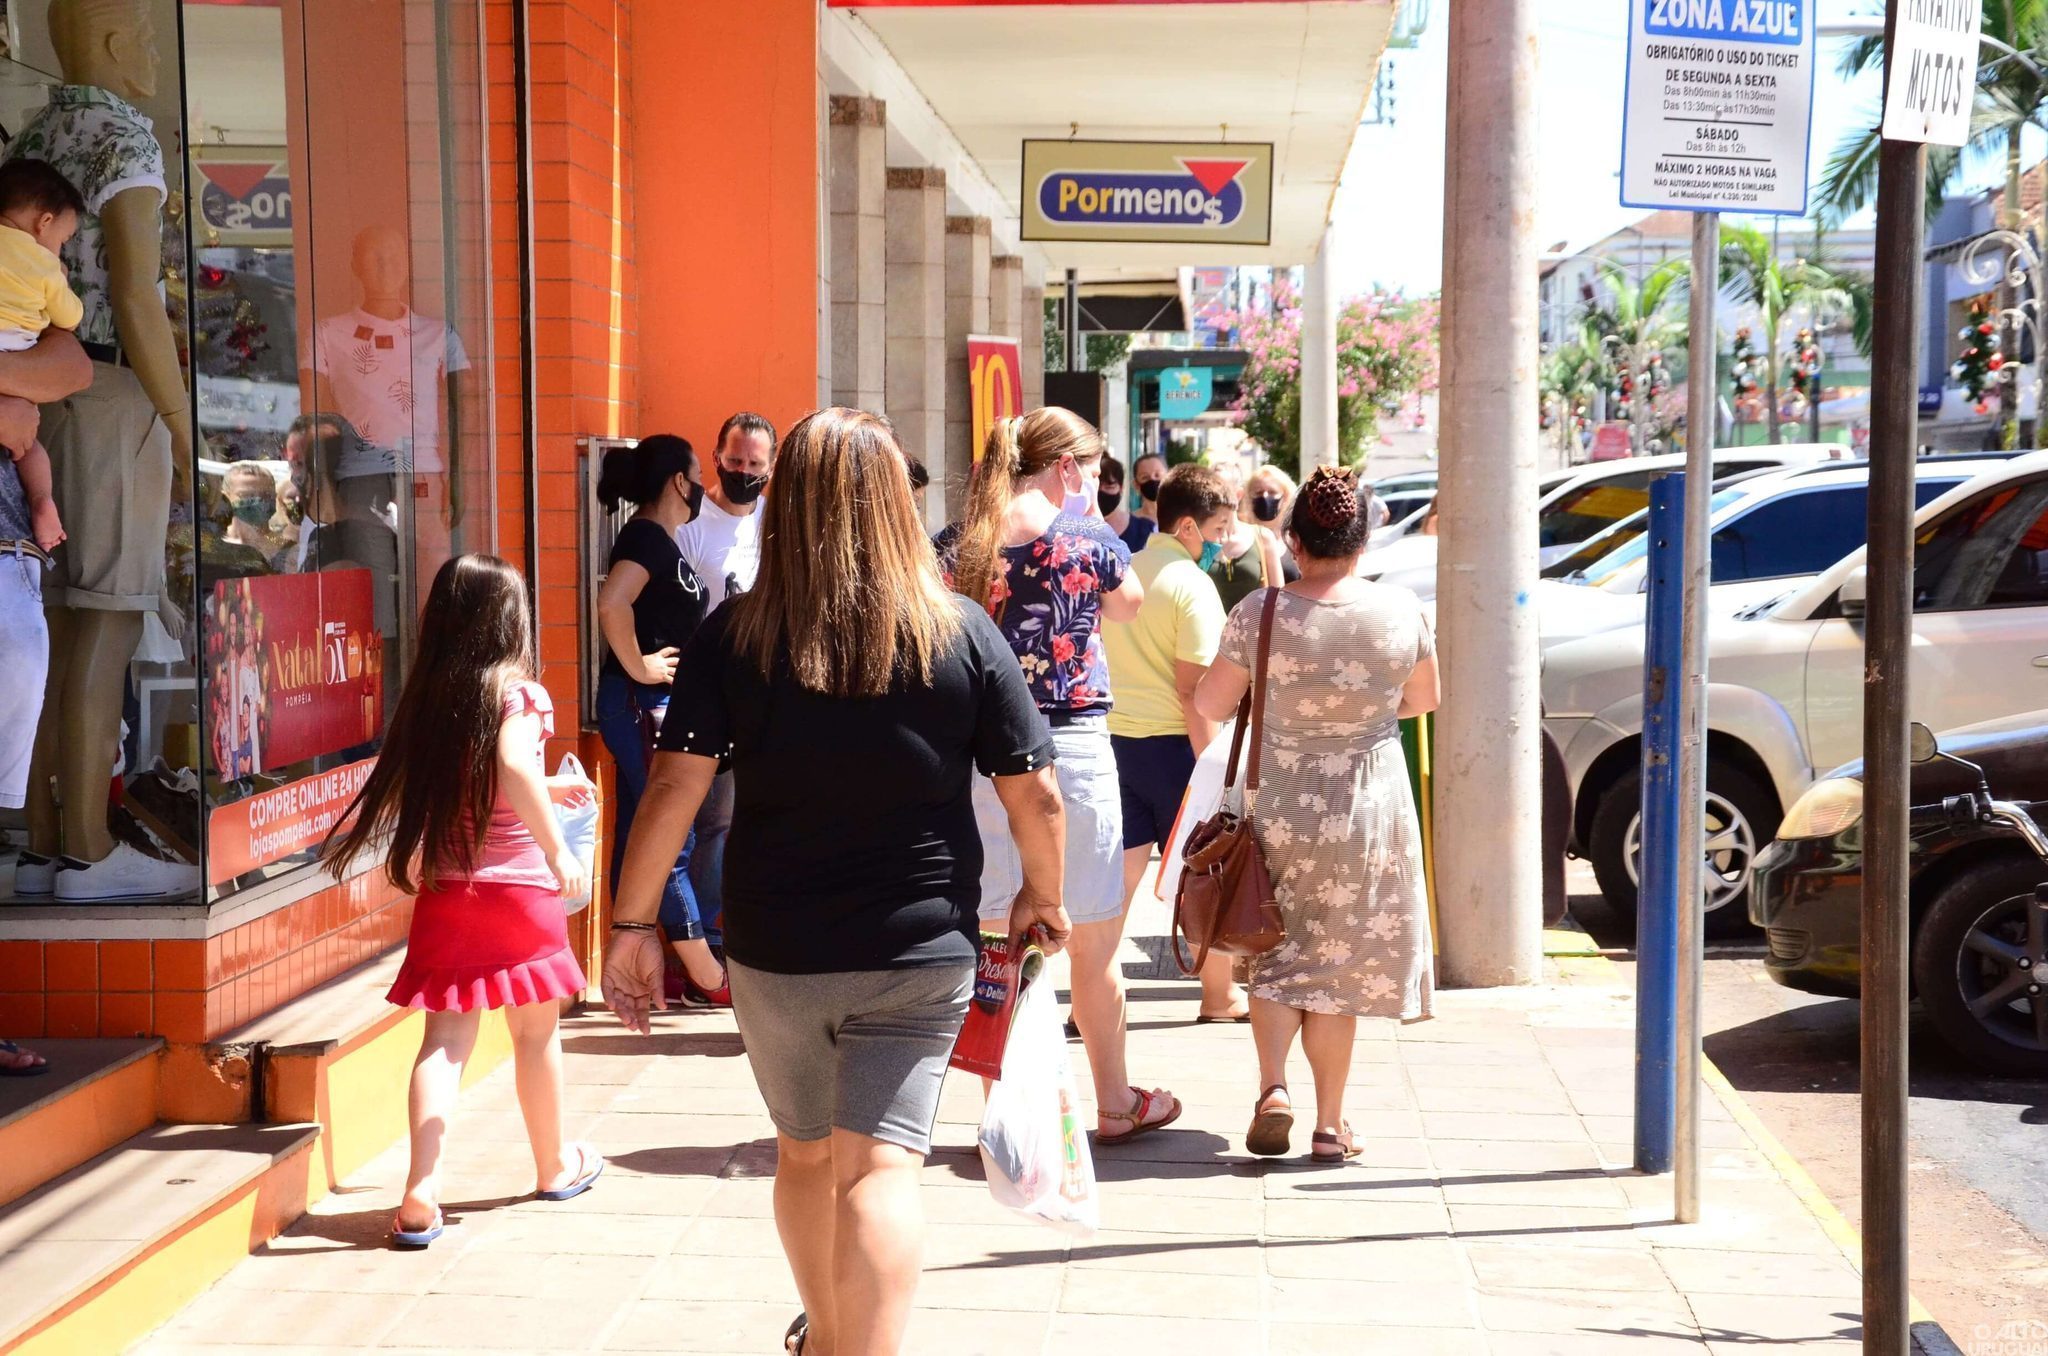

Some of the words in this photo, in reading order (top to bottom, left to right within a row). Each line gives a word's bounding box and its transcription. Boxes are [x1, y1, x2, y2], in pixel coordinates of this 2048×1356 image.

[1650, 0, 1724, 31] ZONA
[1730, 1, 1798, 36] AZUL
[1646, 43, 1714, 62] OBRIGATÓRIO
[1717, 49, 1724, 63] O
[1727, 50, 1747, 64] USO
[1750, 52, 1764, 66] DO
[1767, 53, 1799, 68] TICKET
[1666, 69, 1679, 81] DE
[1682, 70, 1732, 85] SEGUNDA
[1734, 73, 1742, 86] A
[1745, 74, 1777, 88] SEXTA
[1905, 48, 1964, 116] MOTOS
[1664, 85, 1681, 96] Das
[1683, 86, 1720, 98] 8h00min
[1722, 88, 1732, 99] às
[1735, 90, 1776, 101] 11h30min
[1663, 99, 1680, 110] Das
[1696, 124, 1739, 140] SÁBADO
[1686, 141, 1702, 152] Das
[1705, 142, 1716, 152] 8h
[1731, 143, 1746, 153] 12h
[1655, 160, 1694, 174] MÁXIMO
[1697, 164, 1703, 175] 2
[1705, 165, 1737, 176] HORAS
[1739, 167, 1751, 177] NA
[1754, 168, 1777, 178] VAGA
[1654, 178, 1667, 187] NÃO
[1669, 179, 1710, 189] AUTORIZADO
[1713, 181, 1734, 190] MOTOS
[1742, 182, 1775, 192] SIMILARES
[1669, 190, 1679, 198] Lei
[1681, 191, 1712, 201] Municipal
[272, 628, 322, 691] Natal
[285, 692, 312, 708] POMPÉIA
[249, 787, 297, 829] COMPRE
[299, 773, 338, 811] ONLINE
[340, 769, 352, 797] 24
[250, 810, 331, 862] lojaspompeia.com
